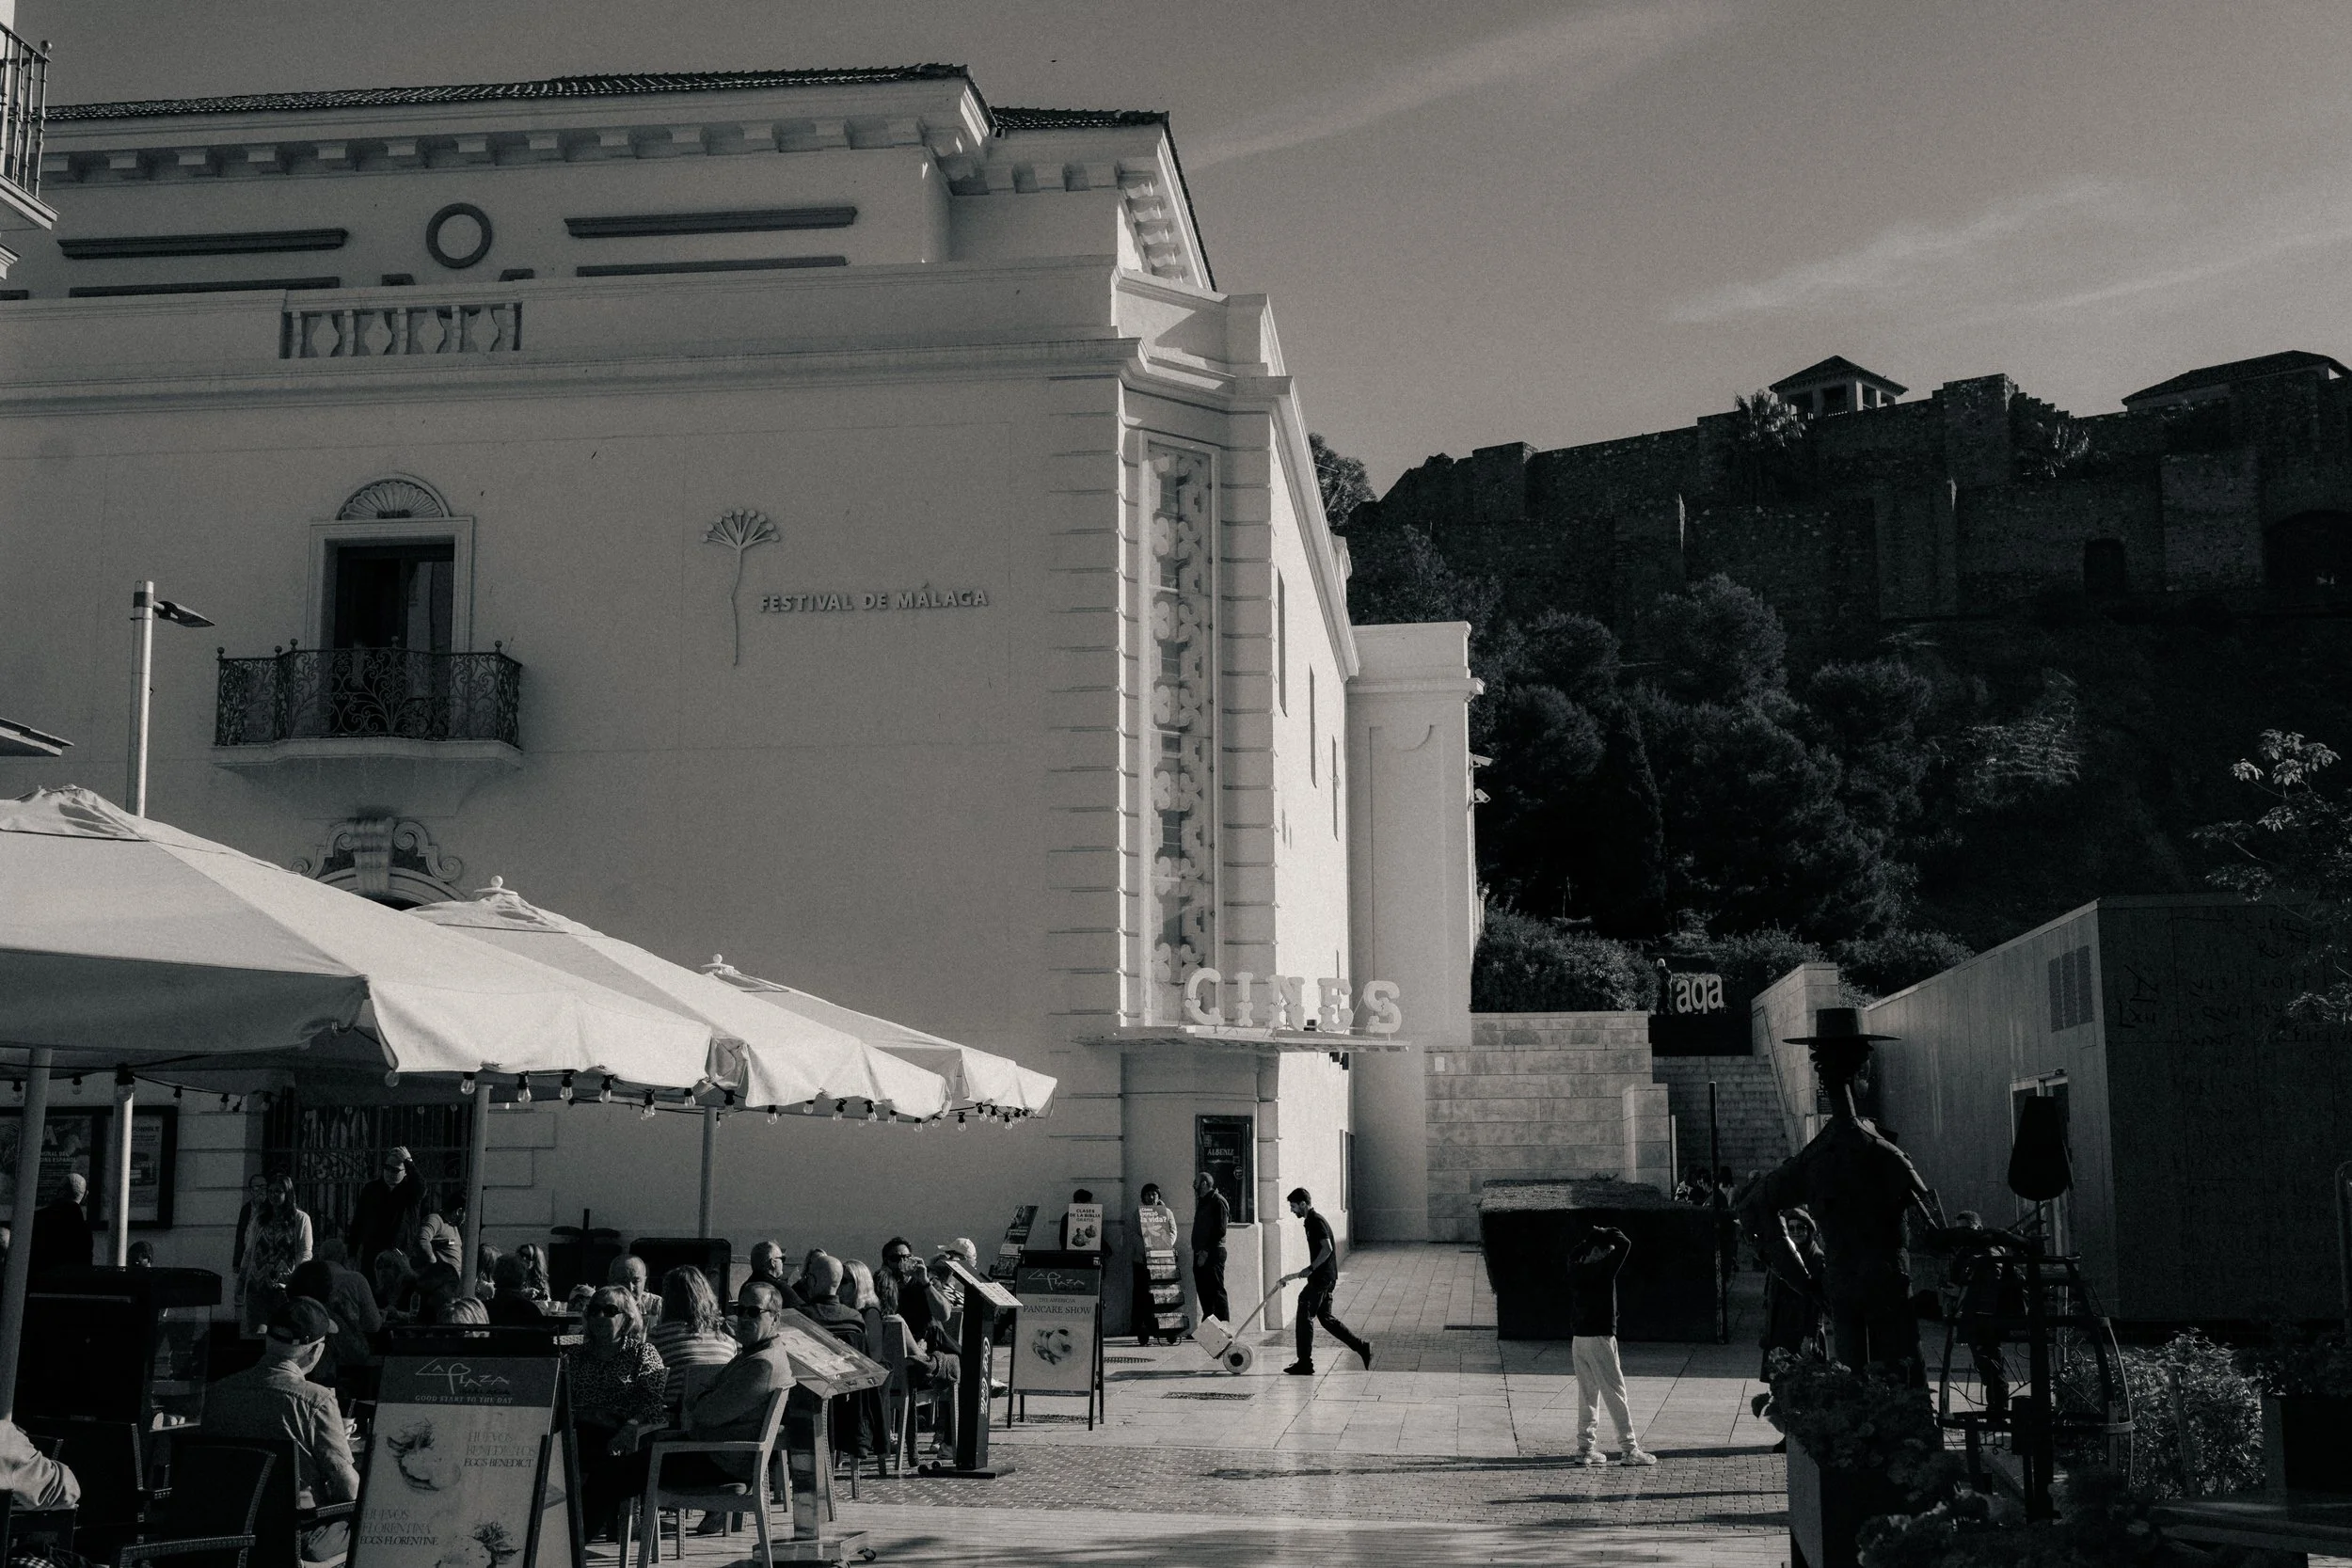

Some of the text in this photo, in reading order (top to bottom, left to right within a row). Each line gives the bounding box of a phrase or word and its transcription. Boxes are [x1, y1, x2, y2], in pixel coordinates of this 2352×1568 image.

[759, 581, 989, 612] FESTIVAL DE MÁLAGA
[1184, 967, 1402, 1034] CINES
[1023, 1305, 1063, 1313] PANCAKE
[464, 1458, 534, 1468] EGGS BENEDICT
[359, 1535, 439, 1545] EGGS FLORENTINE
